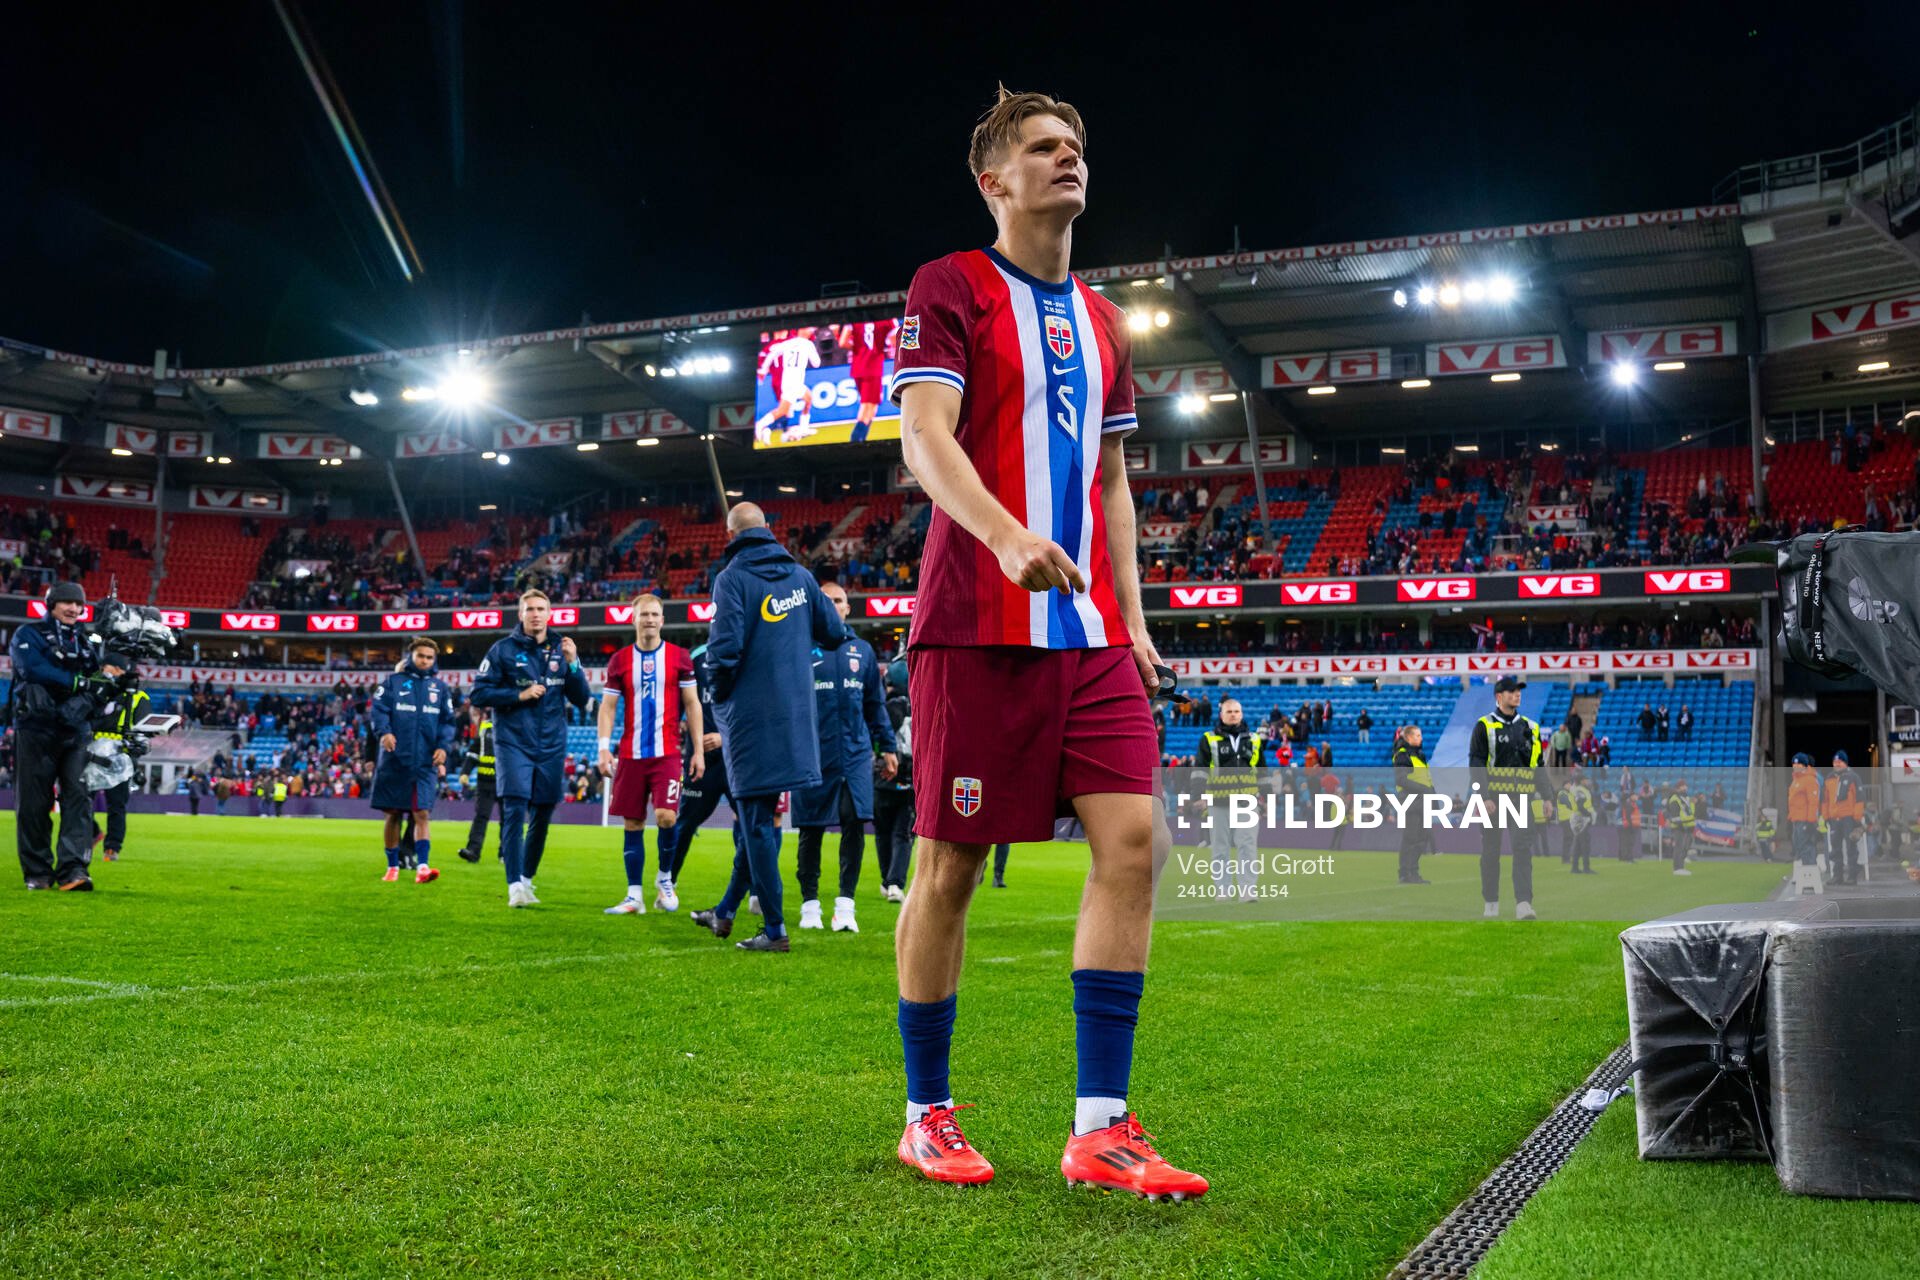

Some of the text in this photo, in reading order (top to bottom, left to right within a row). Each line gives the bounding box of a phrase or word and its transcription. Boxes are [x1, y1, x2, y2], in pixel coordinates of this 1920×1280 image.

[1265, 248, 1300, 261] VG
[1316, 243, 1353, 255] VG
[1368, 238, 1405, 251] VG
[1420, 232, 1457, 245] VG
[1473, 226, 1512, 240] VG
[1527, 221, 1566, 235] VG
[1582, 216, 1622, 229] VG
[1638, 210, 1680, 223] VG
[1696, 205, 1737, 218] VG
[1815, 297, 1920, 335] VG
[1441, 341, 1548, 370] VG
[1604, 330, 1716, 359] VG
[1276, 354, 1373, 382] VG
[124, 429, 198, 456] VG
[272, 436, 349, 455] VG
[504, 420, 570, 446] VG
[1190, 440, 1283, 464] VG
[67, 476, 149, 501] VG
[202, 487, 278, 510] VG
[771, 588, 807, 614] Bendit
[1173, 571, 1724, 605] VG VG VG VG VG
[1813, 570, 1821, 606] Norway
[225, 614, 276, 629] VG
[311, 615, 355, 630] VG
[385, 614, 426, 629] VG
[456, 611, 498, 627] VG
[1201, 660, 1251, 673] VG
[1265, 659, 1316, 672] VG
[1332, 658, 1385, 671] VG
[1399, 657, 1453, 670] VG
[1469, 656, 1524, 669] VG
[1540, 654, 1596, 668] VG
[1612, 653, 1671, 667] VG
[1687, 652, 1747, 666] VG
[191, 670, 235, 682] VG
[245, 671, 285, 683] VG
[295, 672, 333, 684] VG
[643, 680, 656, 699] 21
